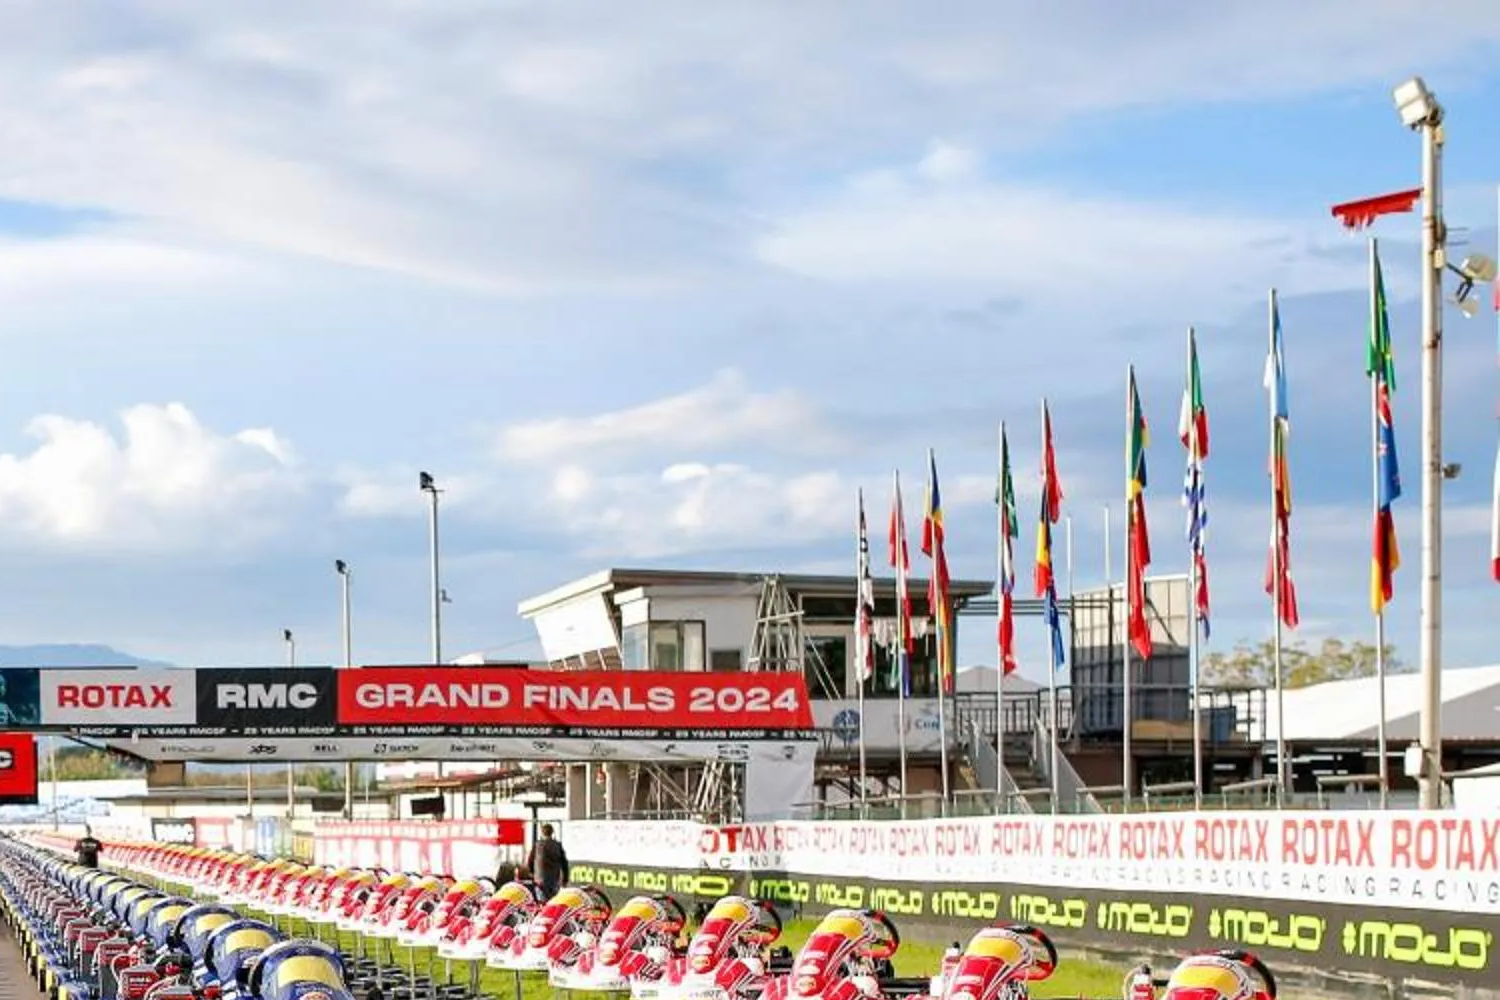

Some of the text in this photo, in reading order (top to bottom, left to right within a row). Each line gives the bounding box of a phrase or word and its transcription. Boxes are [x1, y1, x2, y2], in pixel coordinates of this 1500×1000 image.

[57, 685, 172, 708] ROTAX
[216, 683, 318, 709] RMC
[355, 683, 799, 712] GRAND FINALS 2024
[934, 824, 981, 856] ROTAX
[990, 822, 1044, 856] ROTAX
[1051, 821, 1111, 859] ROTAX
[1119, 820, 1185, 861] ROTAX
[1194, 819, 1270, 863] ROTAX
[1282, 819, 1375, 868] ROTAX
[1390, 819, 1500, 872] ROTAX
[1389, 878, 1500, 903] RACING
